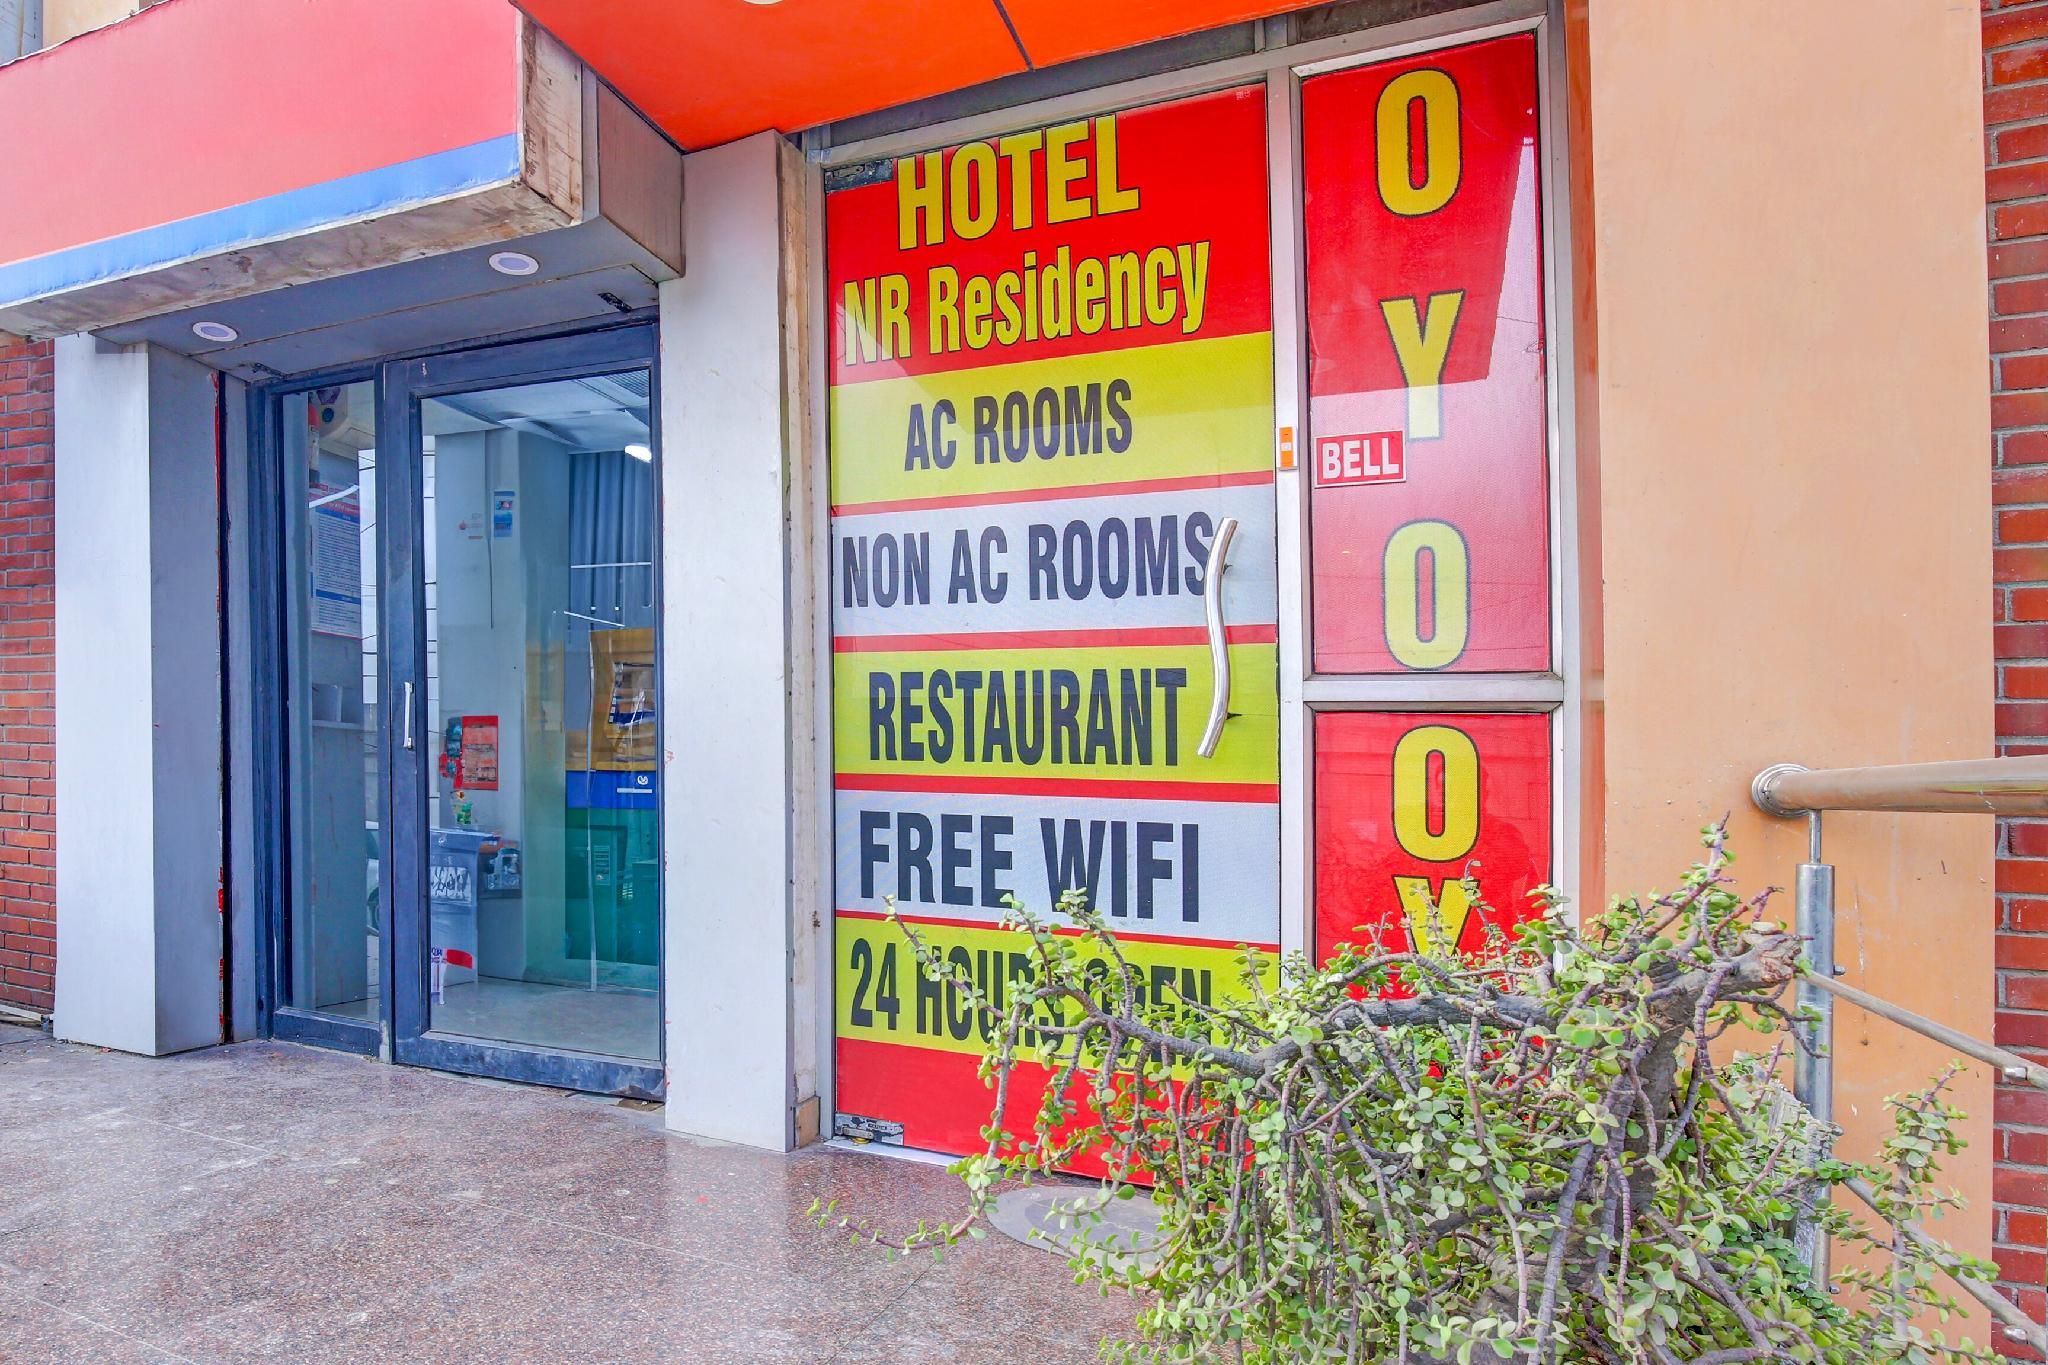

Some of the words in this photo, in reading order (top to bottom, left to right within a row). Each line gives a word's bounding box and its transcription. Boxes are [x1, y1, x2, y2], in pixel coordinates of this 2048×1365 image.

[897, 114, 1140, 251] HOTEL
[843, 273, 911, 366] NR
[928, 240, 1211, 355] Residency
[904, 399, 956, 472] AC
[974, 378, 1133, 465] ROOMS
[1322, 437, 1400, 480] BELL
[842, 532, 930, 608] NON
[947, 525, 1008, 604] AC
[1028, 511, 1213, 601] ROOMS
[869, 667, 1187, 767] RESTAURANT
[860, 810, 1014, 909] FREE
[1039, 817, 1199, 922] WIFI
[850, 937, 900, 1031] 24
